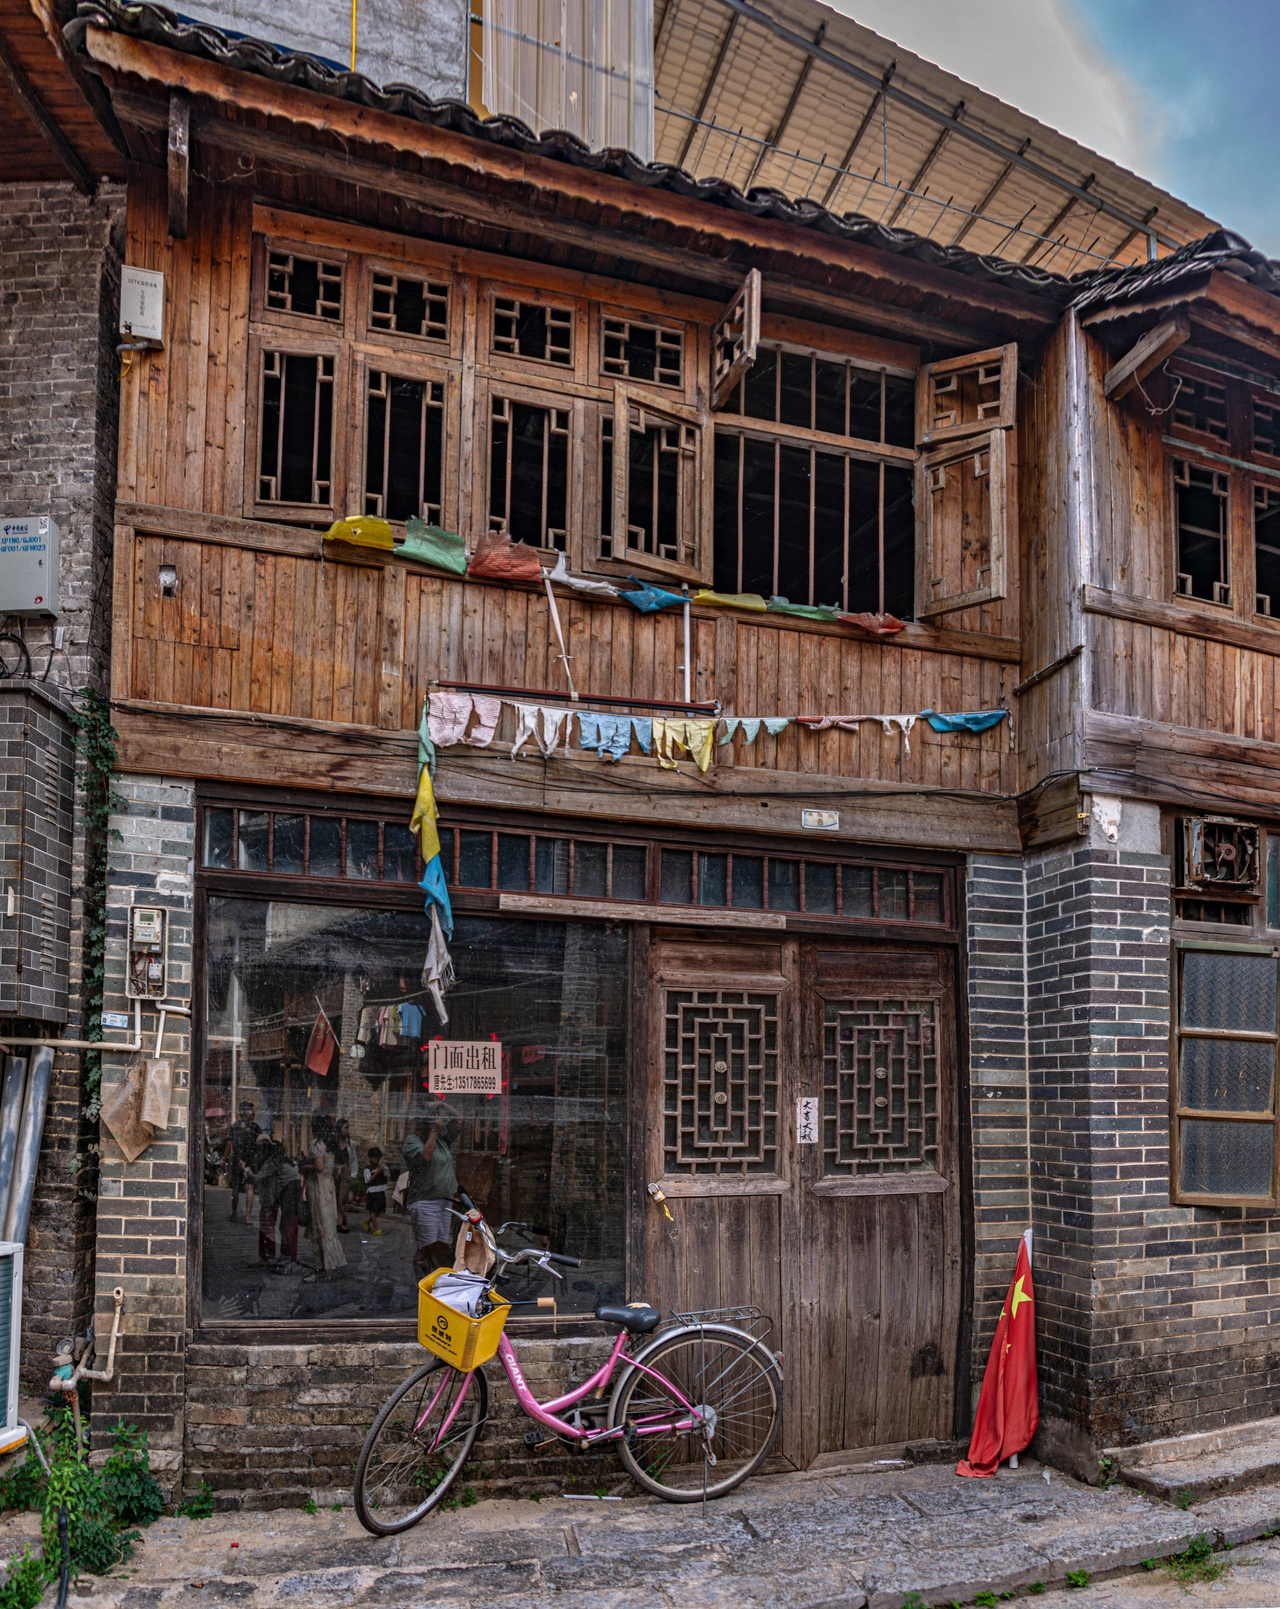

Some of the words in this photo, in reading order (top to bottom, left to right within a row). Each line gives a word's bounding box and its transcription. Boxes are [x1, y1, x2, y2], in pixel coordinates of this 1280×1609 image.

[434, 1044, 497, 1070] 门面出租
[505, 1353, 526, 1392] GIANT
